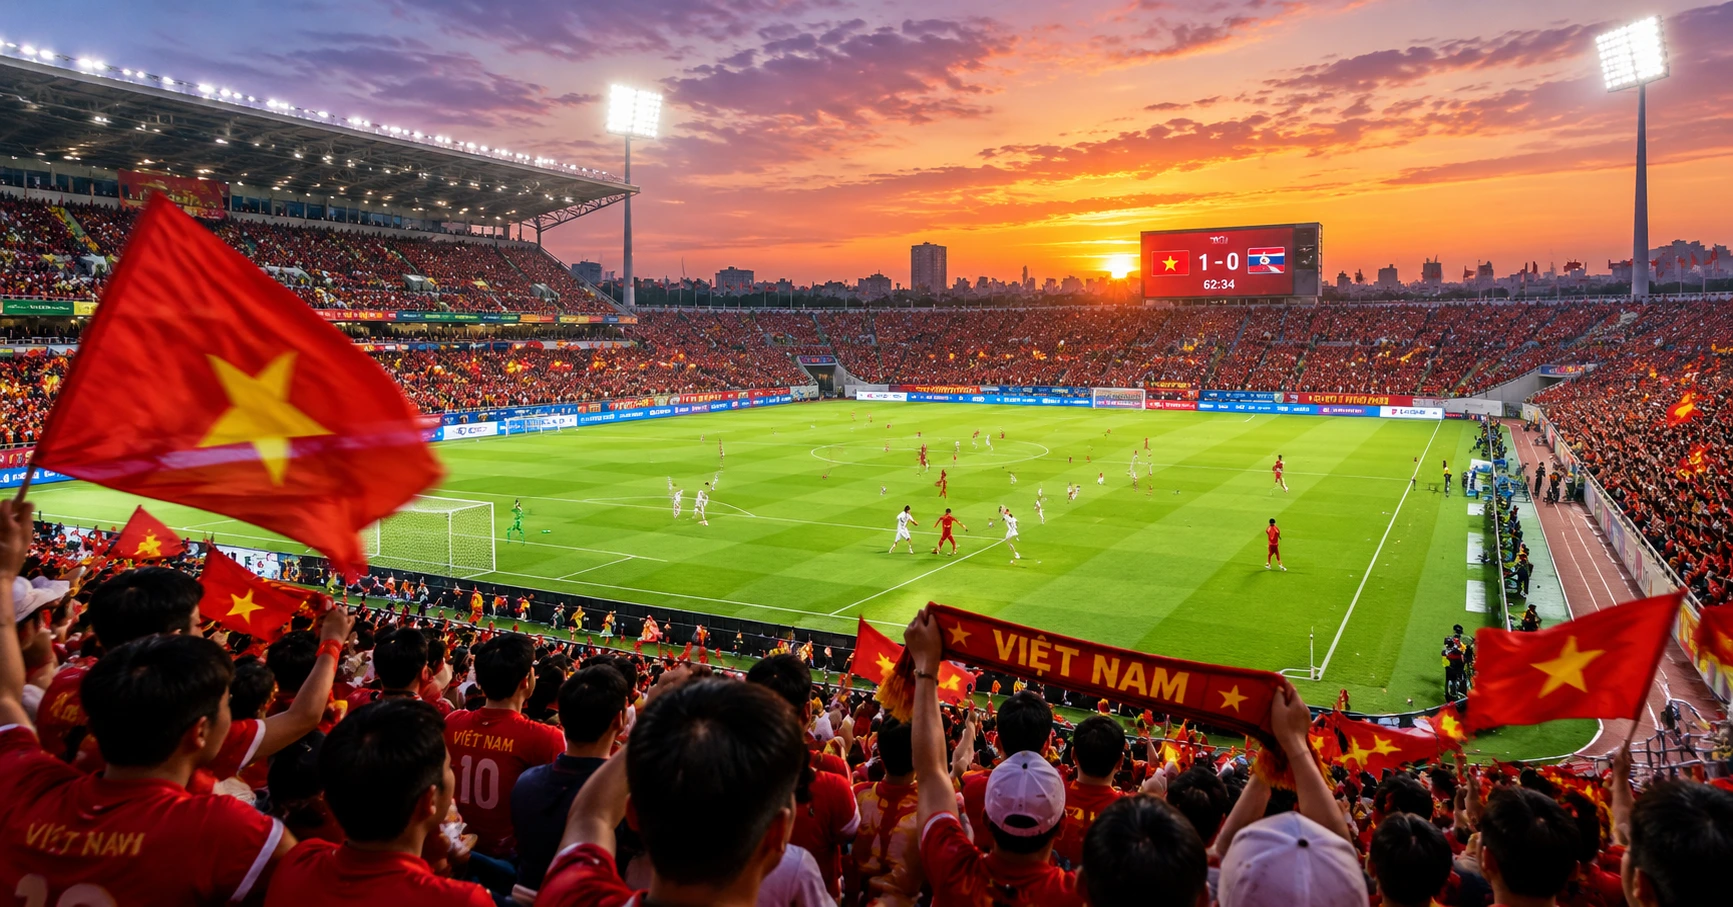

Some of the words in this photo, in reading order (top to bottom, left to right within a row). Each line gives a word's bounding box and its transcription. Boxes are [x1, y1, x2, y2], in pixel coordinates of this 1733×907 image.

[1203, 279, 1236, 290] 62:34
[993, 629, 1080, 676] VIỆT
[1091, 654, 1190, 704] NAM
[483, 734, 515, 753] NAM
[460, 754, 500, 810] 10
